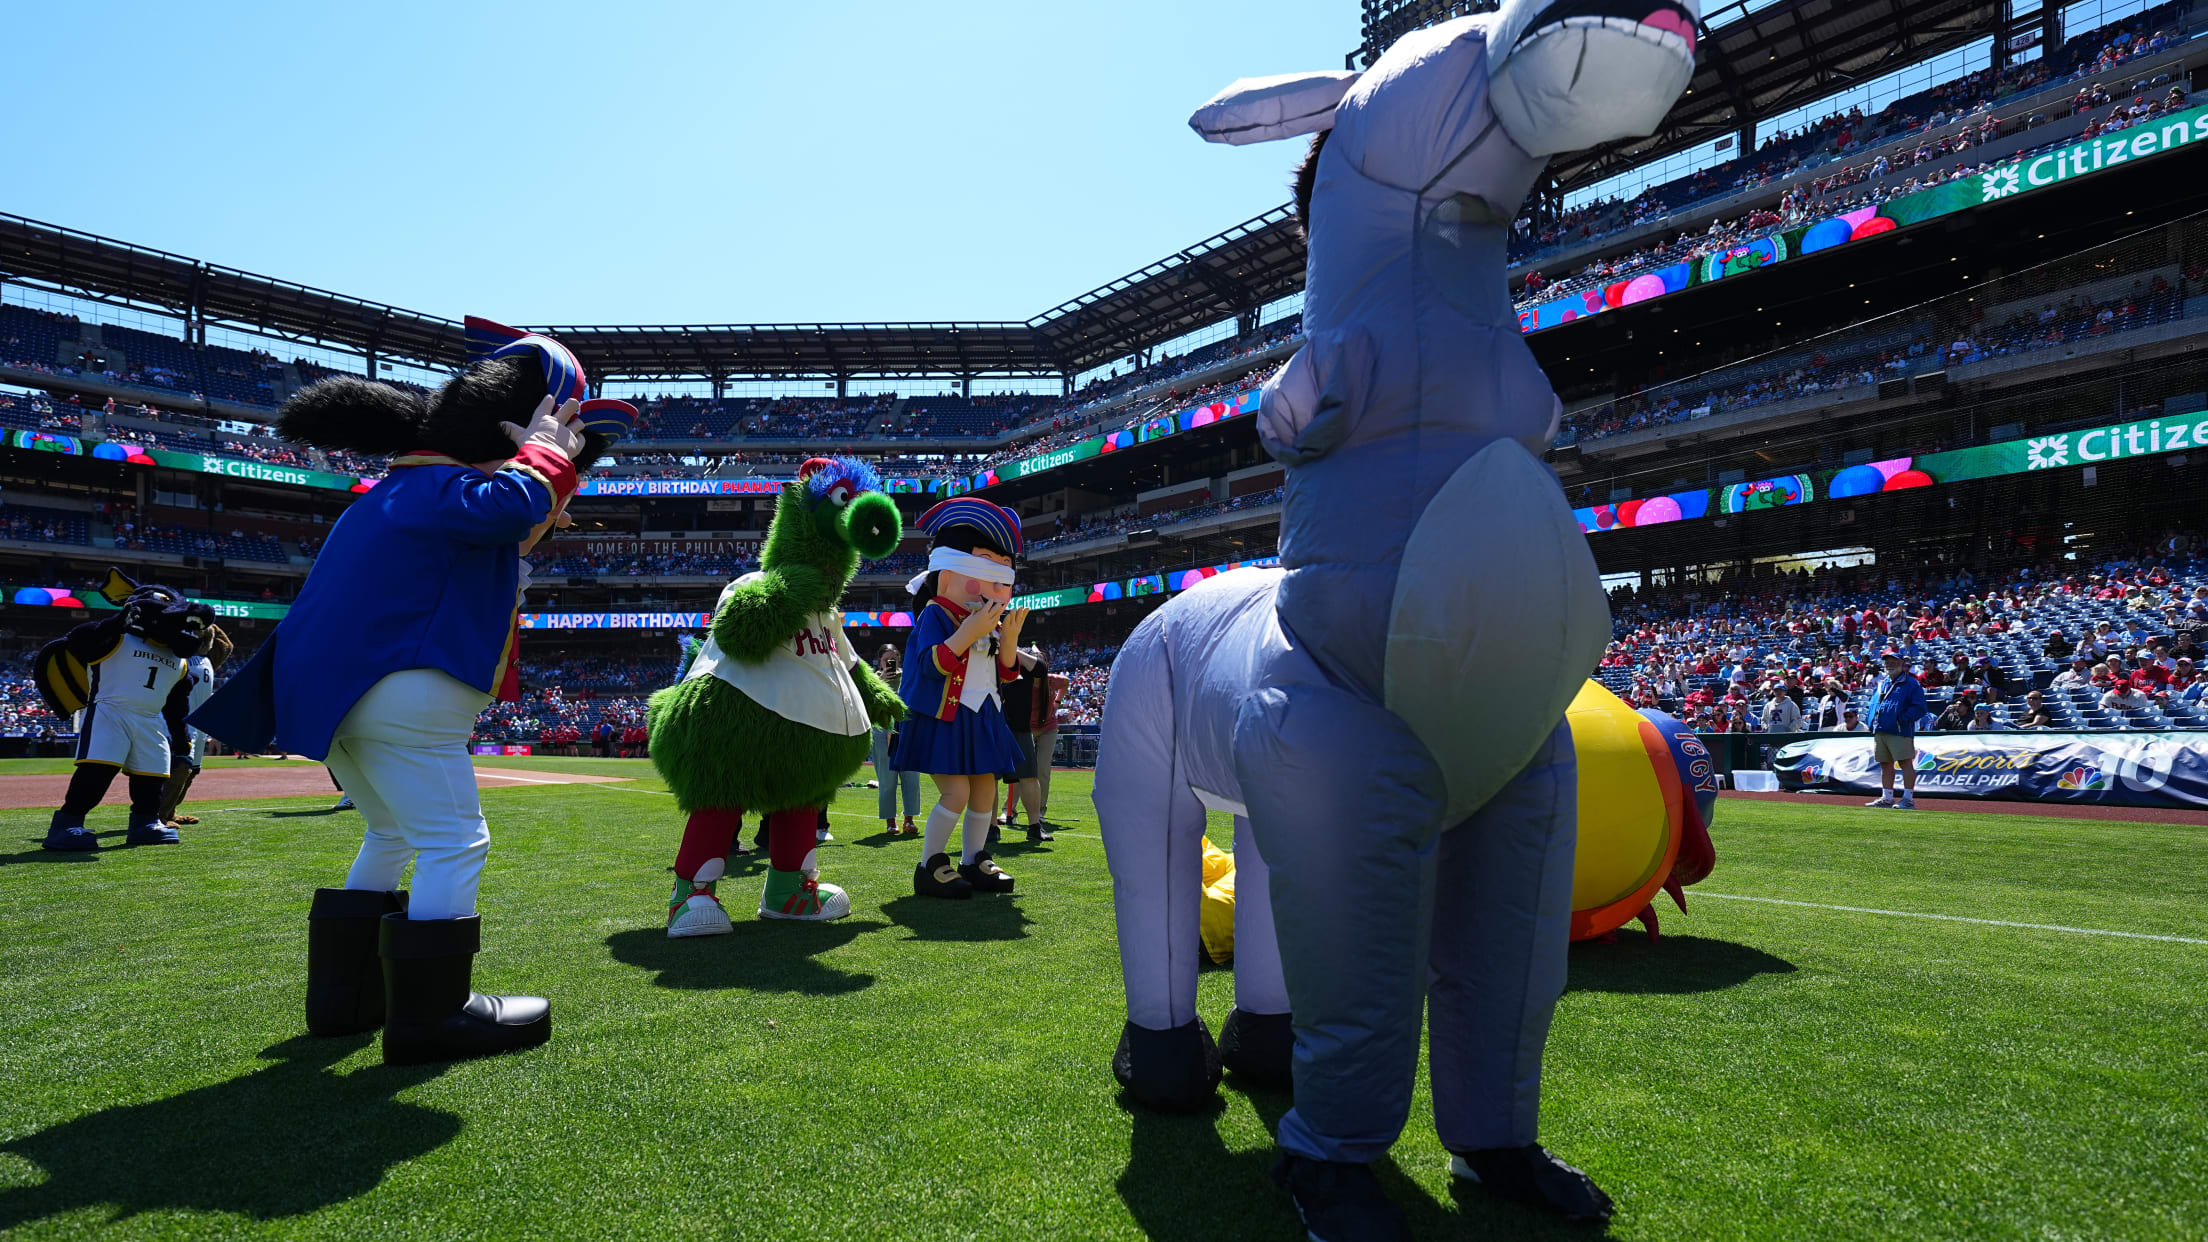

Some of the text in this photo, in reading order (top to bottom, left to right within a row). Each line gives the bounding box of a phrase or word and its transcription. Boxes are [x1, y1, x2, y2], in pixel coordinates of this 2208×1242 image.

[2028, 112, 2208, 187] Citizens
[1030, 450, 1075, 472] Citizens
[226, 460, 307, 485] Citizens
[597, 481, 645, 494] HAPPY
[648, 481, 718, 494] BIRTHDAY
[587, 542, 623, 554] HOME
[631, 542, 646, 554] OF
[653, 542, 677, 554] THE
[1016, 594, 1061, 611] Citizens
[547, 613, 606, 629] HAPPY
[609, 613, 697, 628] BIRTHDAY
[133, 649, 178, 671] DREXEL
[143, 666, 159, 690] 1
[1674, 732, 1717, 793] IGGY
[1935, 748, 2042, 777] Sports
[2098, 751, 2173, 792] 10
[1894, 774, 2020, 786] PILADELPHIA
